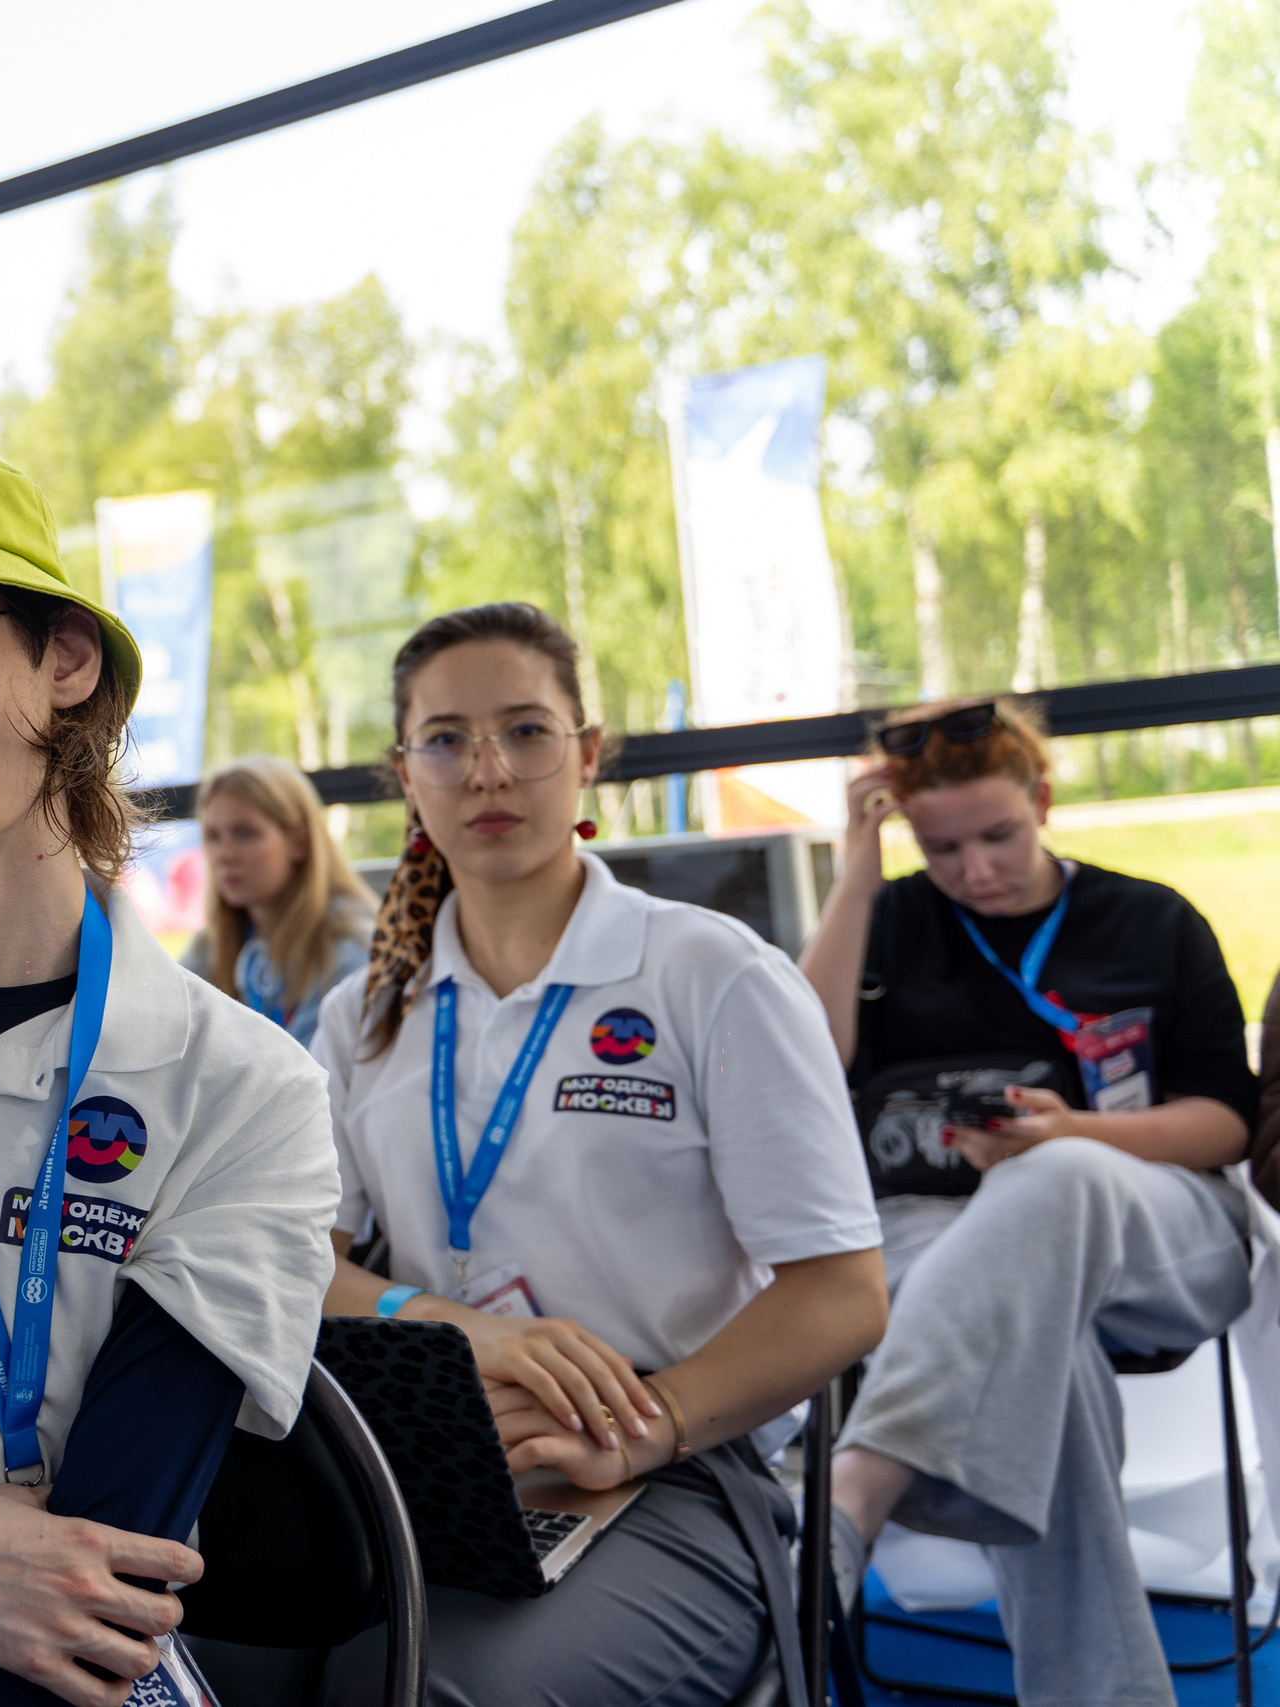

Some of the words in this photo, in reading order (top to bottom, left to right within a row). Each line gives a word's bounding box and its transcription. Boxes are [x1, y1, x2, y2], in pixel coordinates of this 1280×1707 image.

[557, 1091, 674, 1119] МОСКВЫ
[38, 1157, 54, 1210] Летний
[36, 1231, 46, 1272] МОСКВЫ
